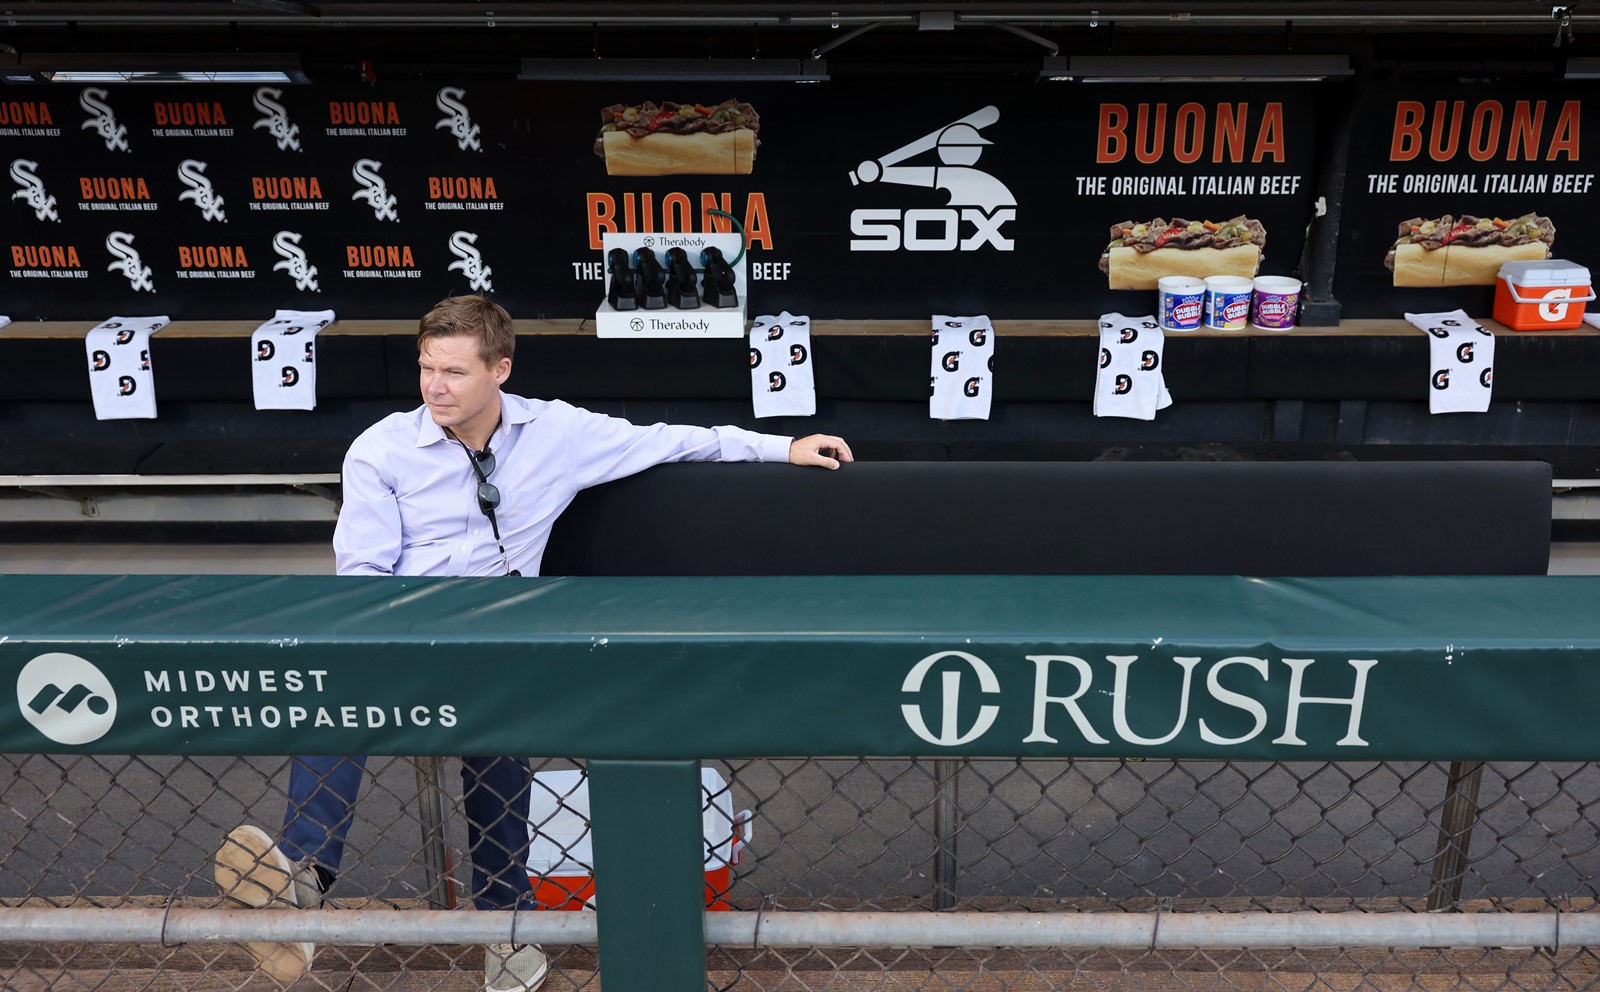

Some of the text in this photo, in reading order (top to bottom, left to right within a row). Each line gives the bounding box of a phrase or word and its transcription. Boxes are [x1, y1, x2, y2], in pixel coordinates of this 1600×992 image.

[0, 102, 53, 125] UONA
[154, 102, 227, 126] BUONA
[328, 102, 400, 126] BUONA
[22, 128, 45, 136] ITALIAN
[46, 128, 60, 136] BEEF
[1096, 102, 1285, 164] BUONA
[1390, 100, 1580, 162] BUONA
[80, 177, 150, 200] BUONA
[252, 177, 323, 200] BUONA
[428, 176, 498, 200] BUONA
[1076, 176, 1300, 195] THE ORIGINAL ITALIAN BEEF
[1368, 174, 1594, 194] THE ORIGINAL ITALIAN BEEF
[78, 202, 158, 210] THE ORIGINAL ITALIAN BEEF
[249, 202, 330, 210] THE ORIGINAL ITALIAN BEEF
[425, 202, 504, 210] THE ORIGINAL ITALIAN BEEF
[586, 192, 774, 250] BUONA
[850, 209, 1016, 251] SOX
[658, 236, 706, 247] Therabody
[11, 246, 82, 268] BUONA
[178, 246, 248, 268] BUONA
[346, 246, 415, 268] BUONA
[10, 270, 88, 278] THE ORIGINAL ITALIAN BEEF
[176, 270, 256, 278] THE ORIGINAL ITALIAN BEEF
[343, 270, 422, 278] THE ORIGINAL ITALIAN BEEF
[572, 262, 792, 280] THE BEEF
[1538, 288, 1572, 322] G
[650, 318, 710, 332] Therabody
[1456, 342, 1474, 364] G
[1432, 368, 1450, 390] G
[144, 670, 328, 692] MIDWEST
[1022, 654, 1379, 746] RUSH
[150, 704, 458, 728] ORTHOPAEDICS
